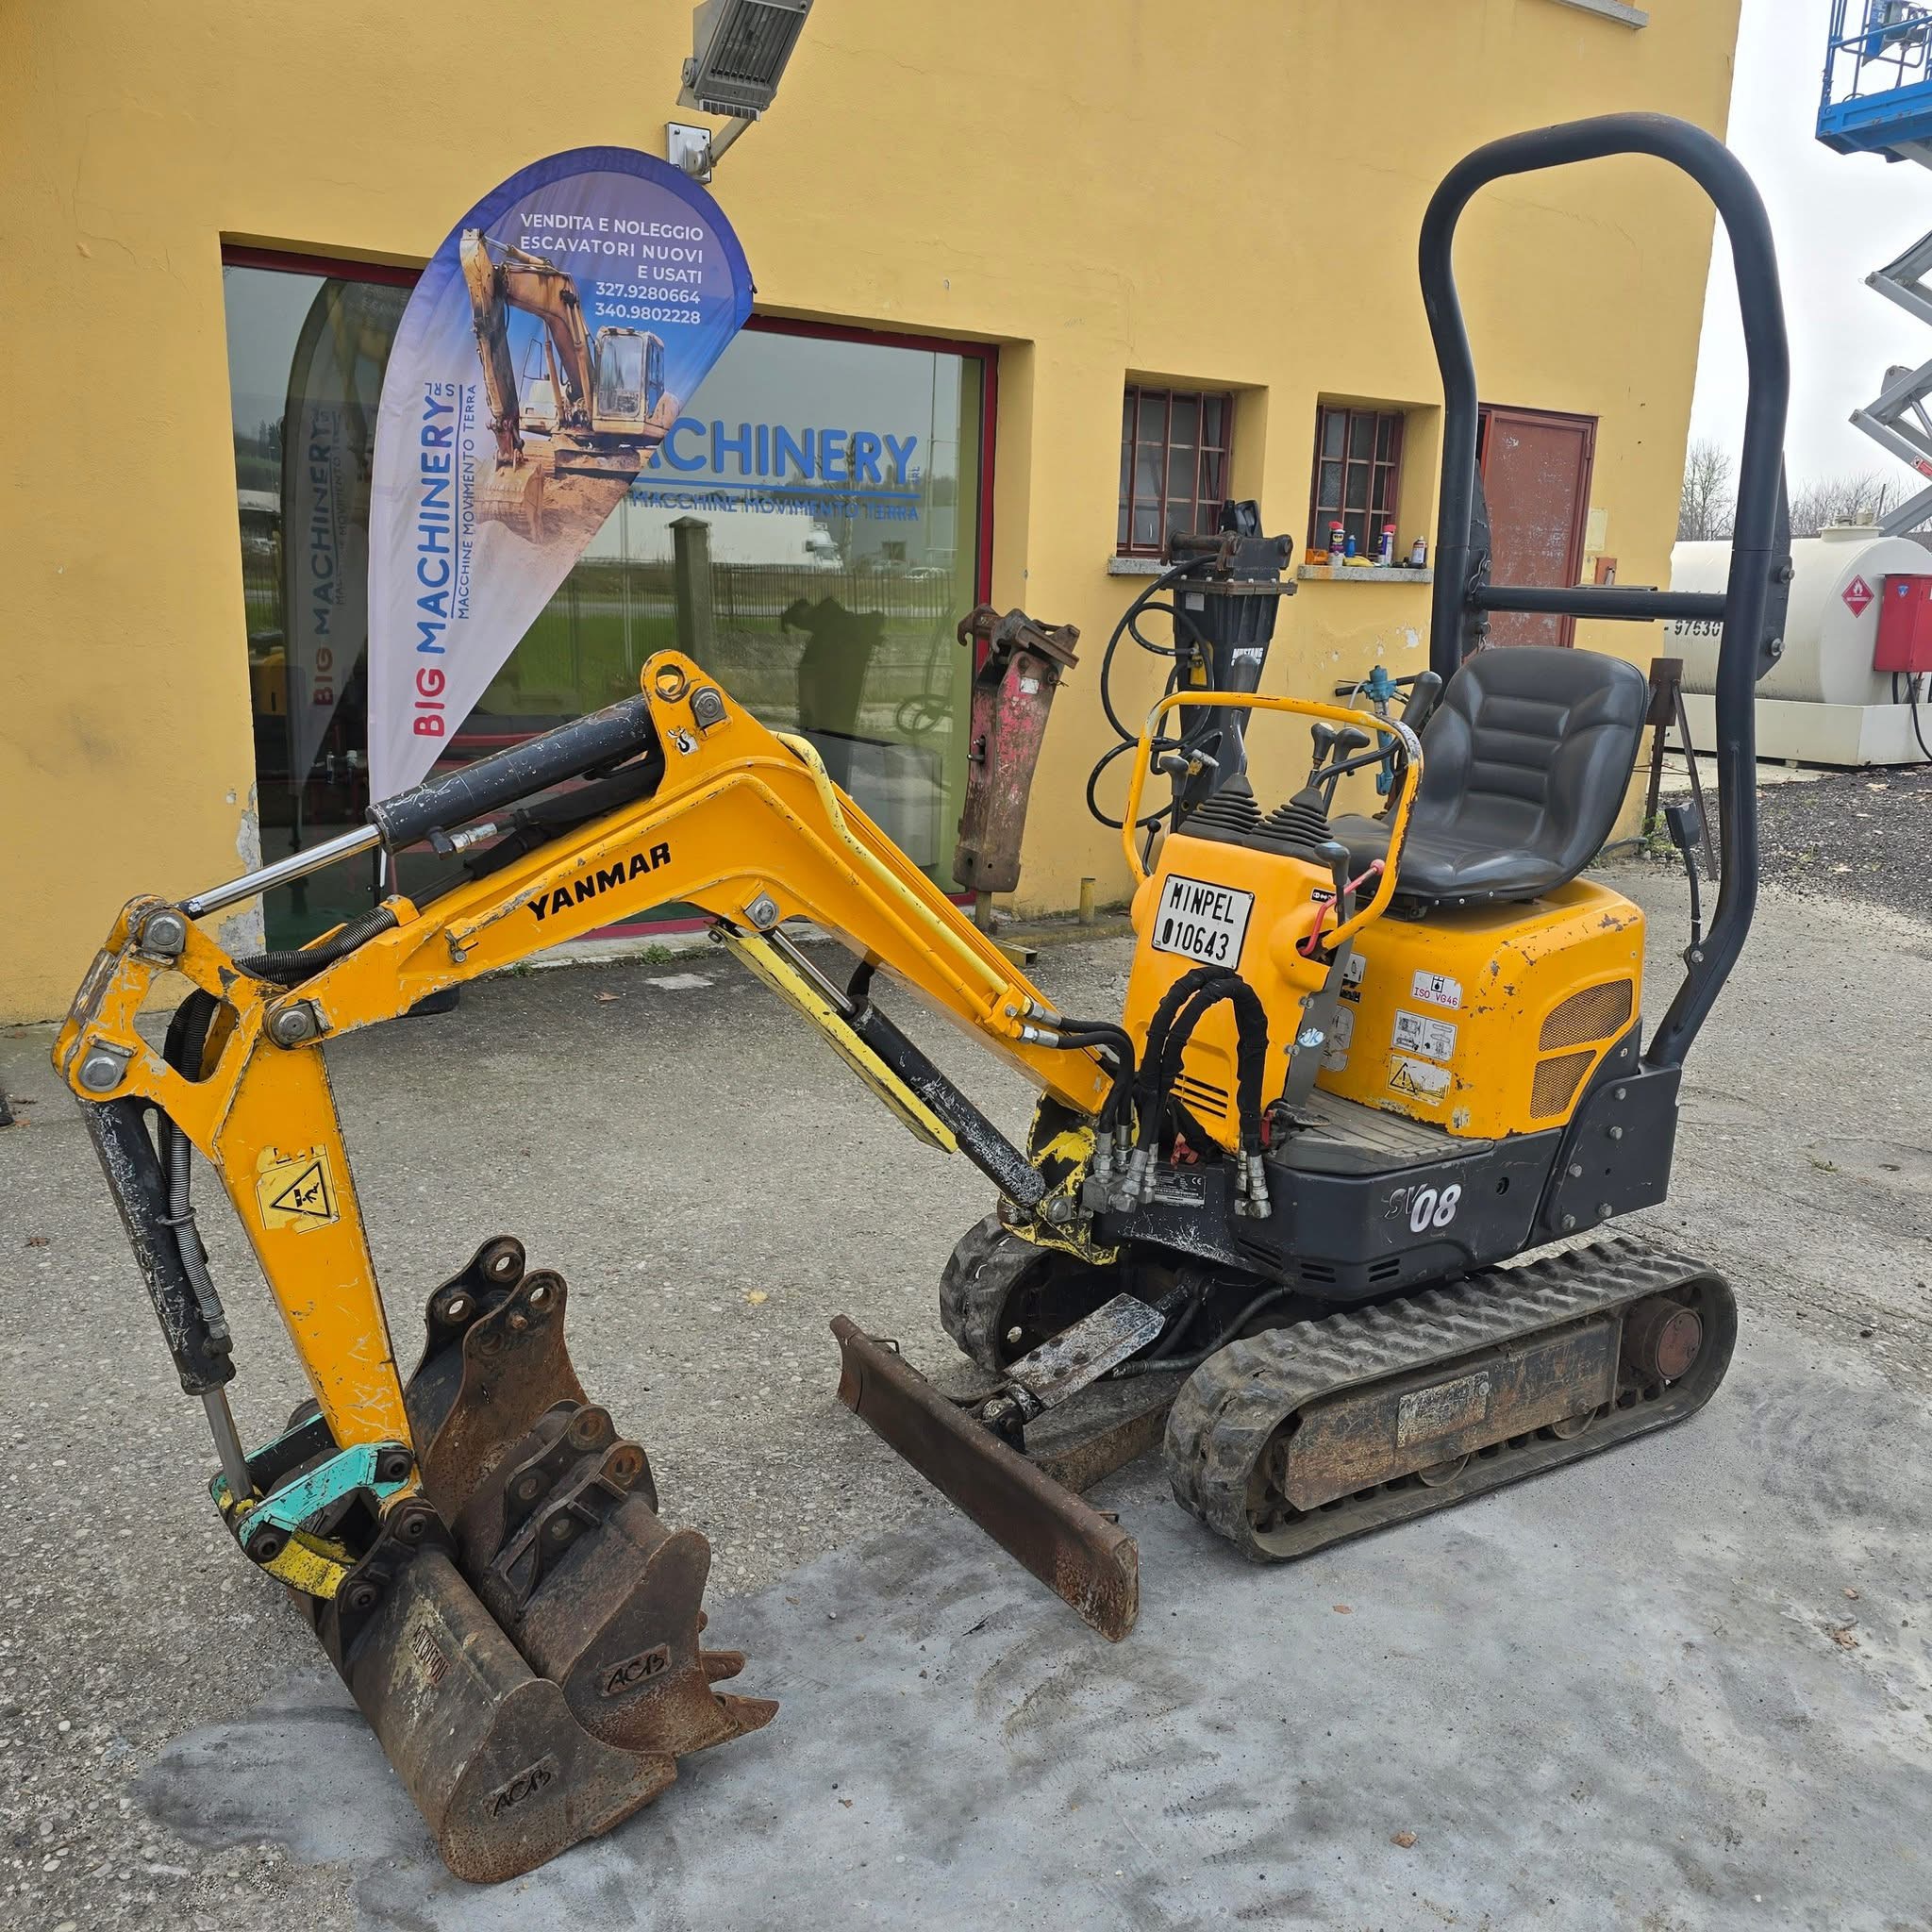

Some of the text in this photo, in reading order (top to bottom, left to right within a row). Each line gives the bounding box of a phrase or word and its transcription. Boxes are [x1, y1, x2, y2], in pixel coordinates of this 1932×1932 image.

[521, 213, 704, 242] VENDITA E NOLEGGIO
[520, 236, 704, 264] ESCAVATORI NUOVI
[638, 265, 702, 284] E USATI
[595, 281, 701, 304] 327.9280664
[594, 302, 701, 325] 340.9802228
[649, 417, 918, 485] CHINERY
[458, 384, 476, 619] MACCHINE MOVIMENTO TERRA
[631, 490, 920, 521] MACCHINE MOVIMENTO TERRA
[413, 382, 455, 737] BIG MACHINERY SRL
[526, 841, 672, 922] YANMAR
[1169, 882, 1234, 924] MINPEL
[1161, 918, 1229, 960] 010643
[1414, 987, 1458, 1007] ISO VG46
